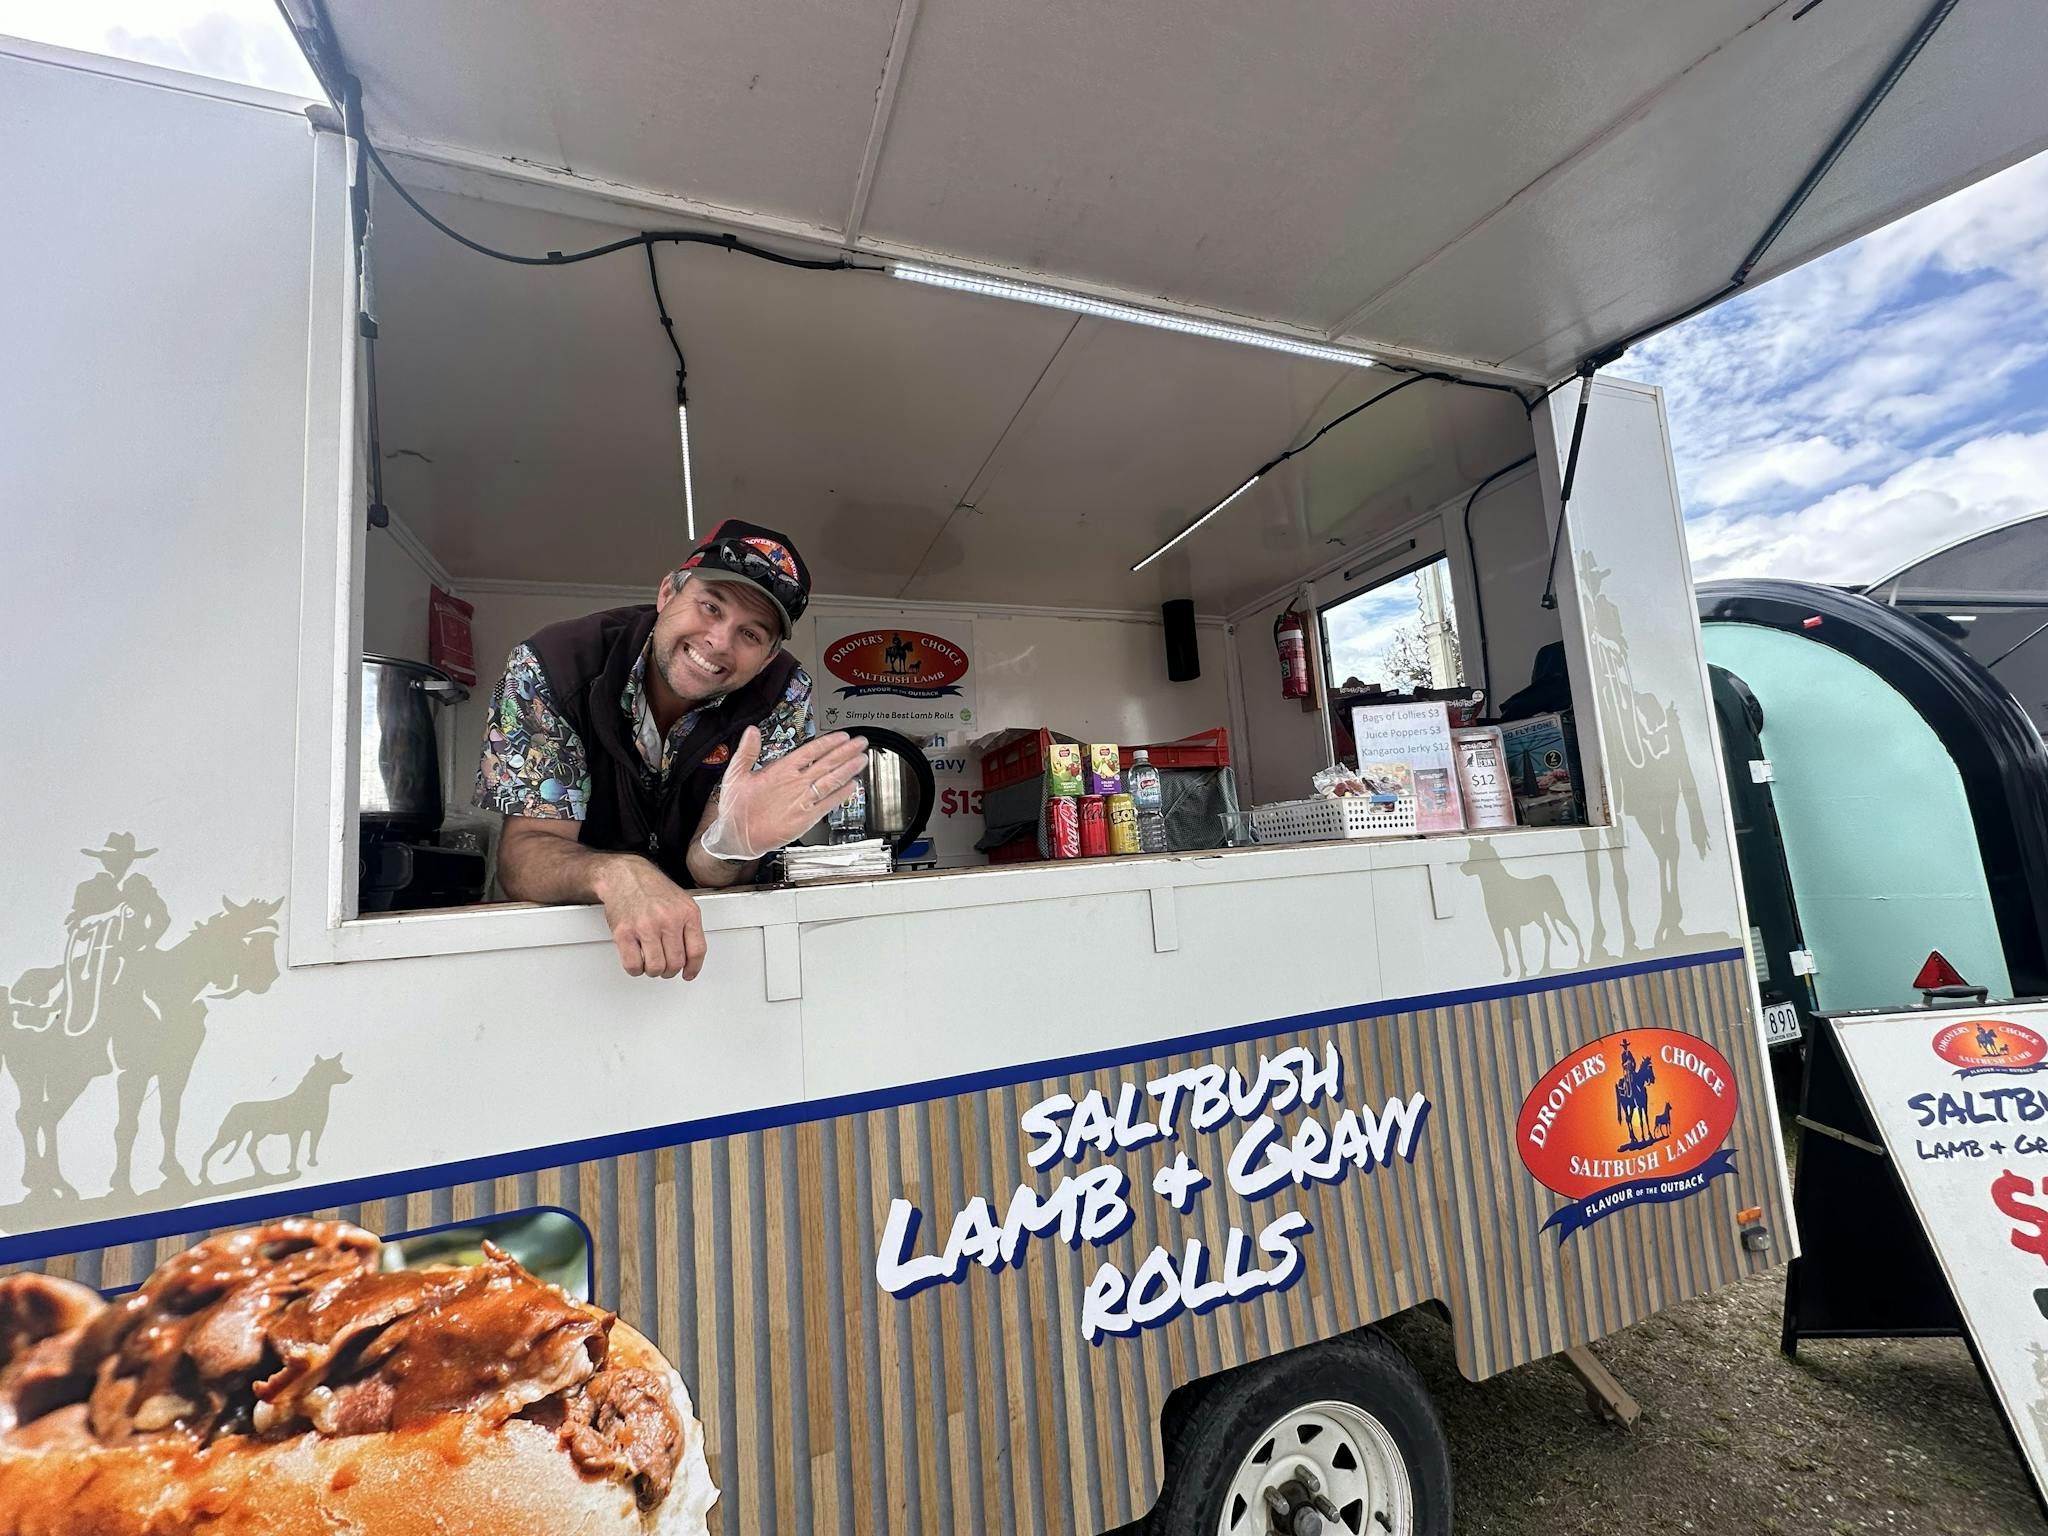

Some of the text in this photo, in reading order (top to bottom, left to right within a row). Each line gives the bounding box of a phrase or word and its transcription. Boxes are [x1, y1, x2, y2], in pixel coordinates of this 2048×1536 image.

[832, 634, 962, 666] DROVER'S CHOICE
[852, 668, 945, 684] SALTBUSH LAMB
[846, 711, 954, 721] Simply the Best Lamb Rolls
[1362, 708, 1440, 724] Bags of Lollies $3
[1366, 726, 1441, 739] Juice Poppers $3
[1362, 742, 1450, 757] Kangaroo Jerky $12
[1549, 752, 1557, 762] 2
[929, 758, 966, 773] ravy
[1471, 773, 1496, 787] $12
[941, 787, 985, 818] $13
[1112, 810, 1136, 824] SOL
[1999, 1026, 2040, 1045] CHOICE
[2008, 1051, 2032, 1062] LAMB
[1020, 1040, 1341, 1168] SALTBUSH
[1529, 1045, 1725, 1148] DROVER'S CHOICE
[1569, 1120, 1709, 1178] SALTBUSH LAMB
[1916, 1139, 1984, 1160] LAMB
[876, 1164, 1131, 1294] LAMB
[1227, 1091, 1427, 1197] GRAVY
[1585, 1173, 1705, 1218] FLAVOUR OF THE OUTBACK
[1081, 1210, 1307, 1342] ROLLS
